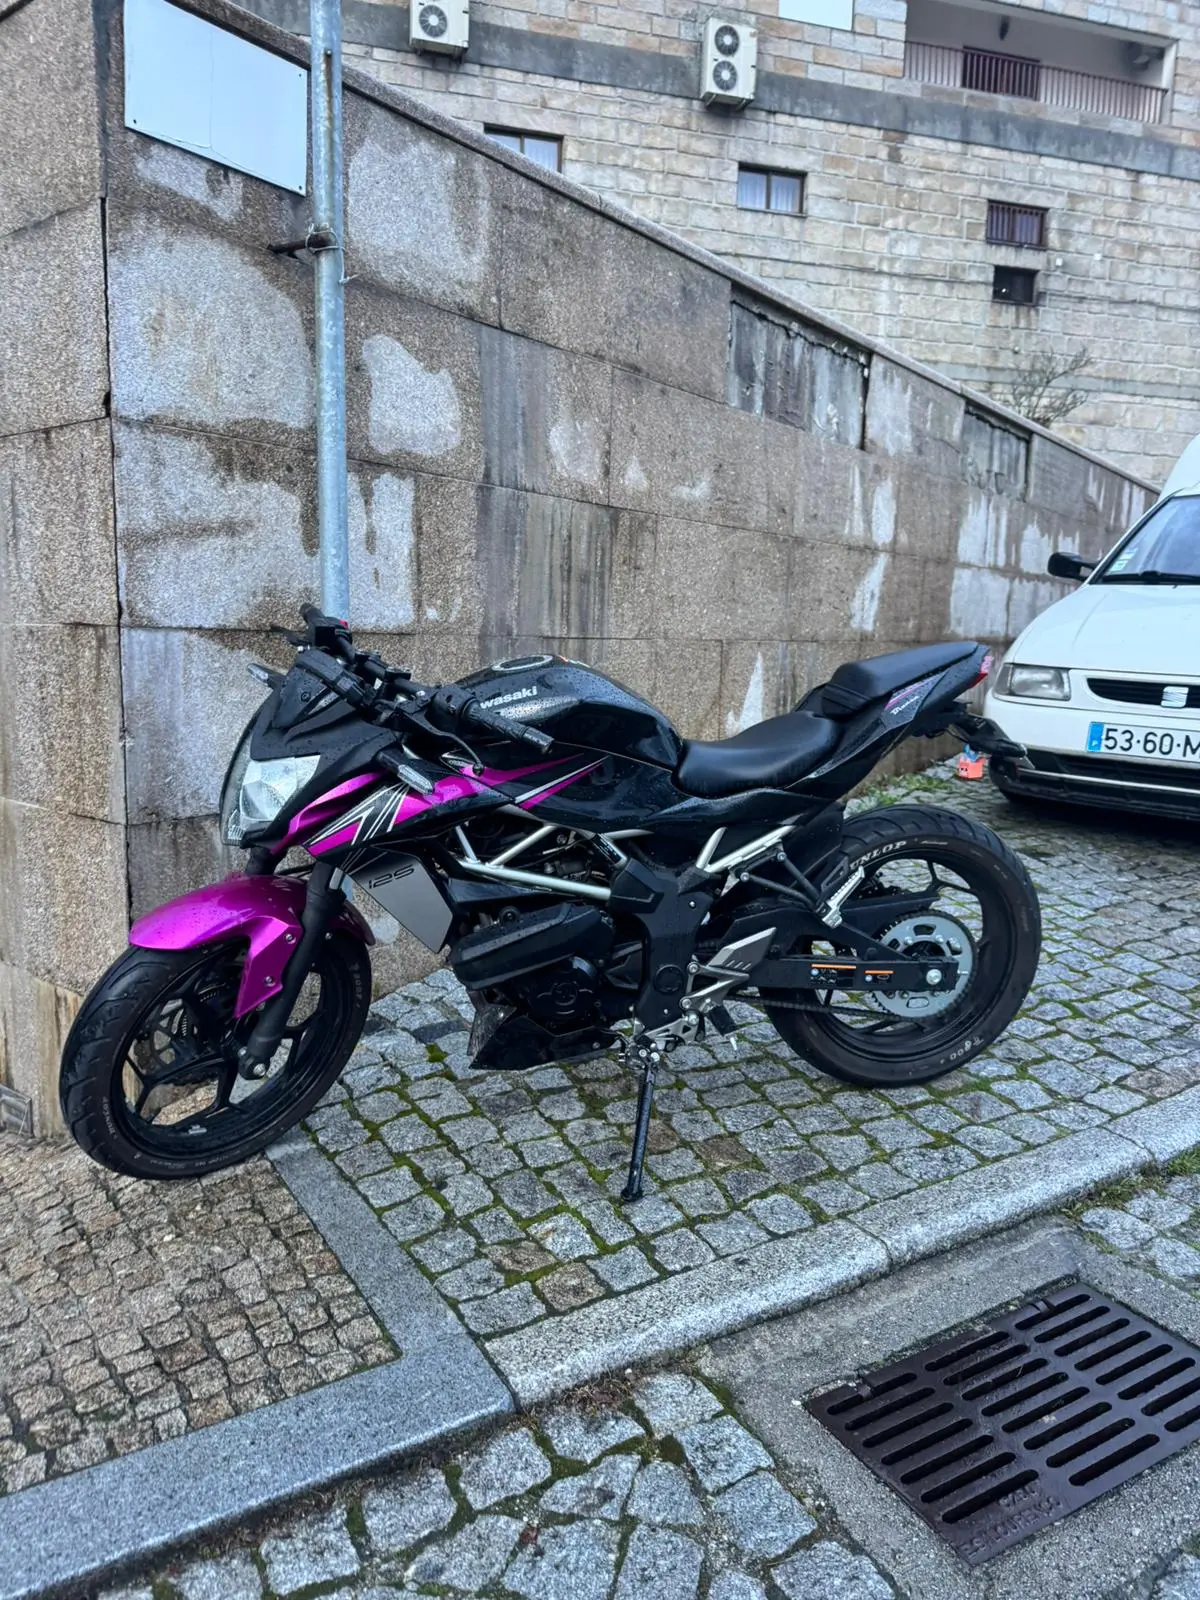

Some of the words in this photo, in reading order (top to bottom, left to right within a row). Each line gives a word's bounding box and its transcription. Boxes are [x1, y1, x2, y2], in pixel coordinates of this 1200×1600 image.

[480, 686, 538, 709] wasaki
[849, 840, 907, 870] UNLOP
[369, 864, 414, 889] 125
